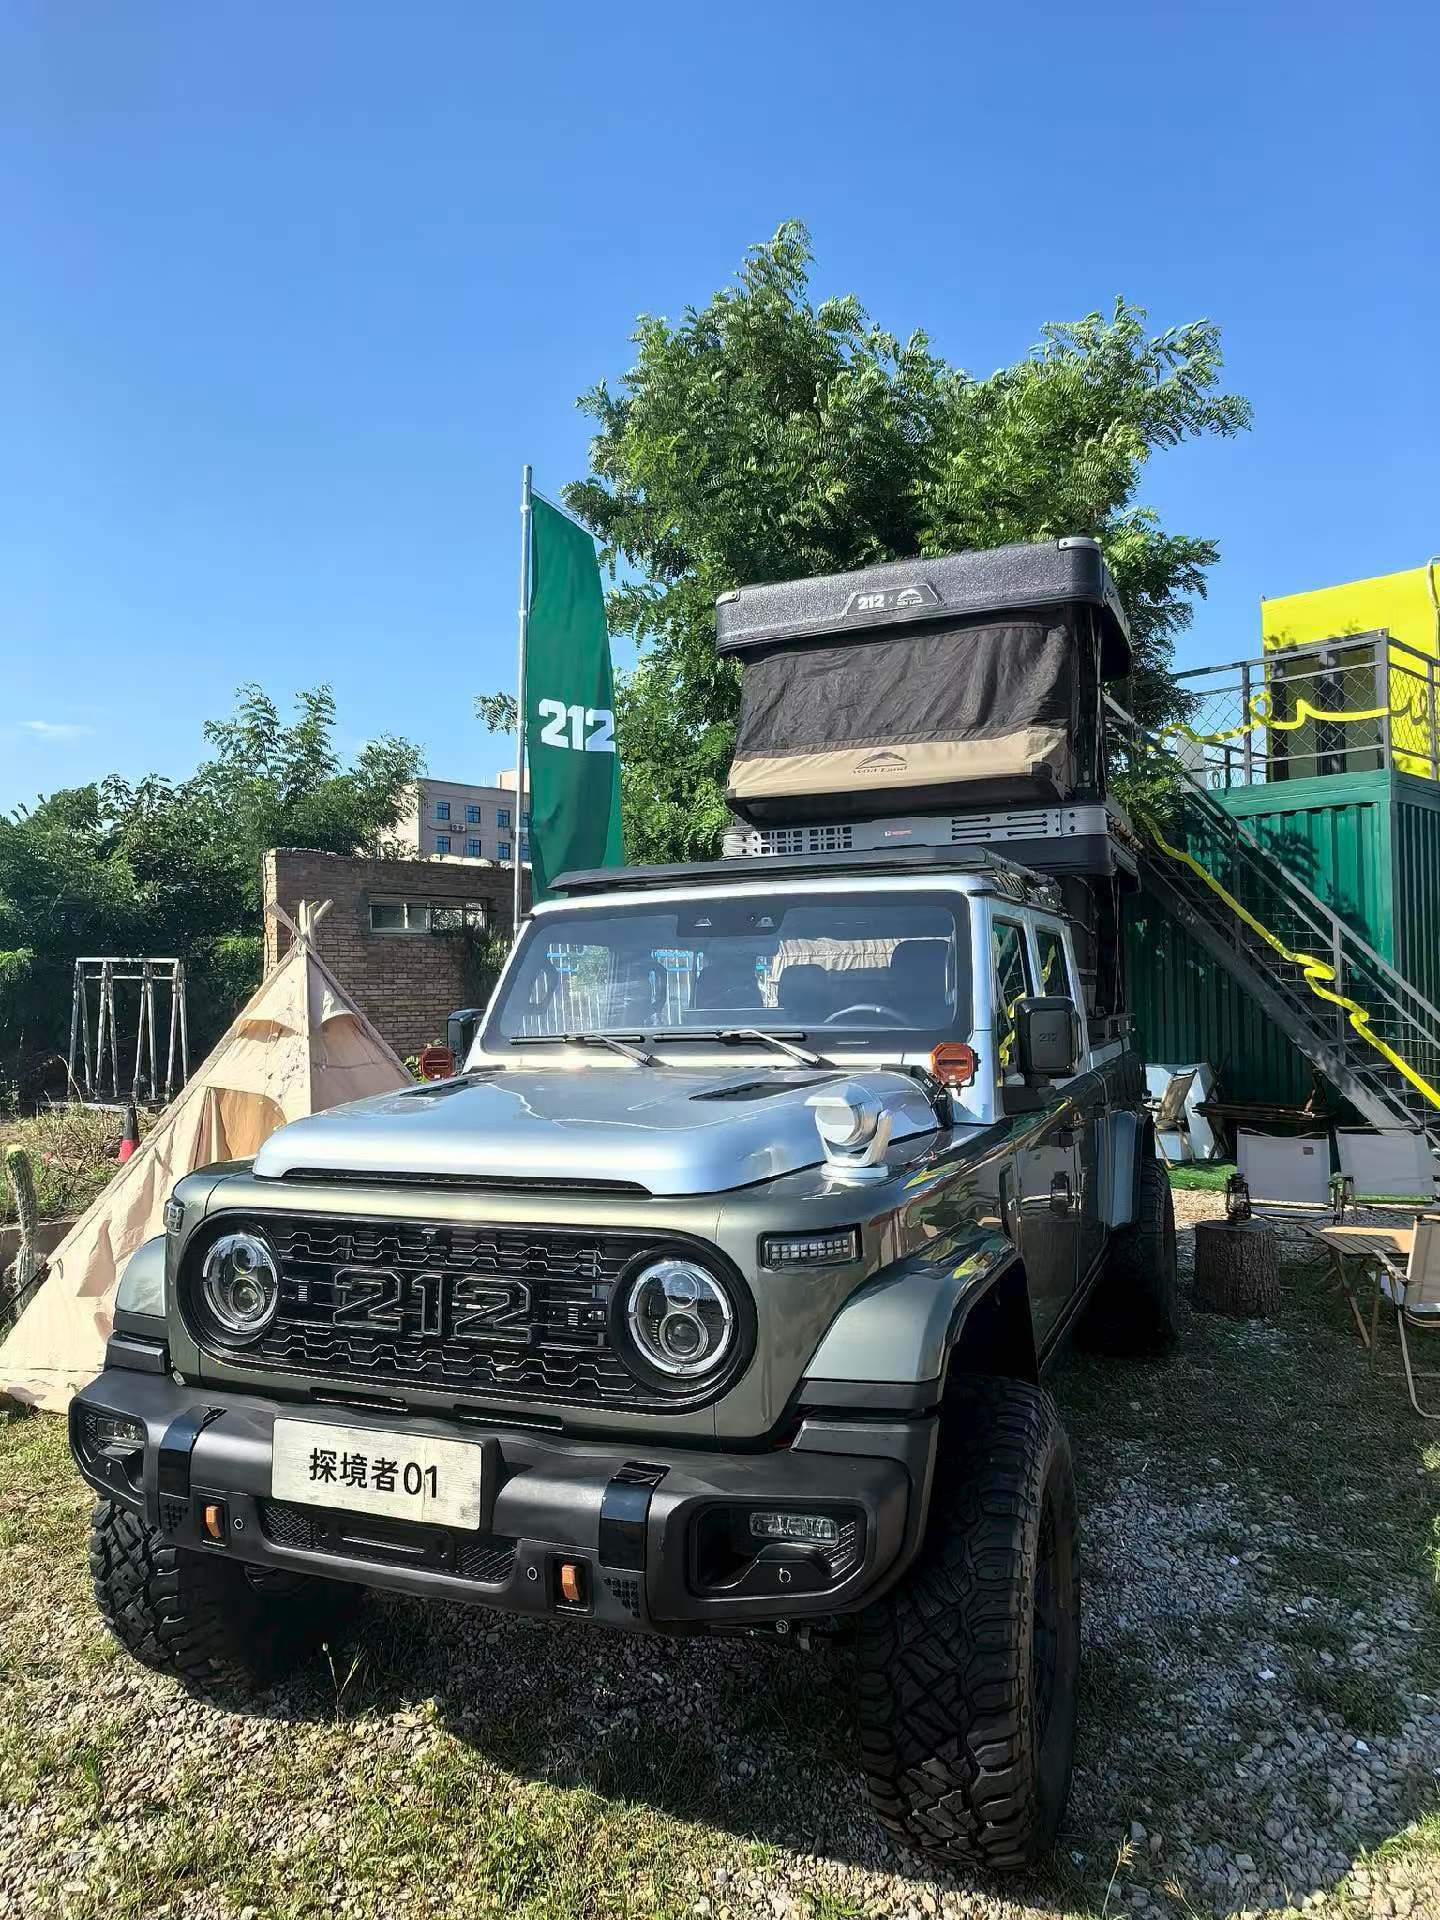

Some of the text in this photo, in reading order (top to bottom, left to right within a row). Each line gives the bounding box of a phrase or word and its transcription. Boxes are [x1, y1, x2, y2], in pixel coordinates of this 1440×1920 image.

[858, 594, 885, 610] 212
[538, 698, 616, 753] 212
[332, 1268, 533, 1344] 212
[309, 1447, 438, 1499] 探境者01
